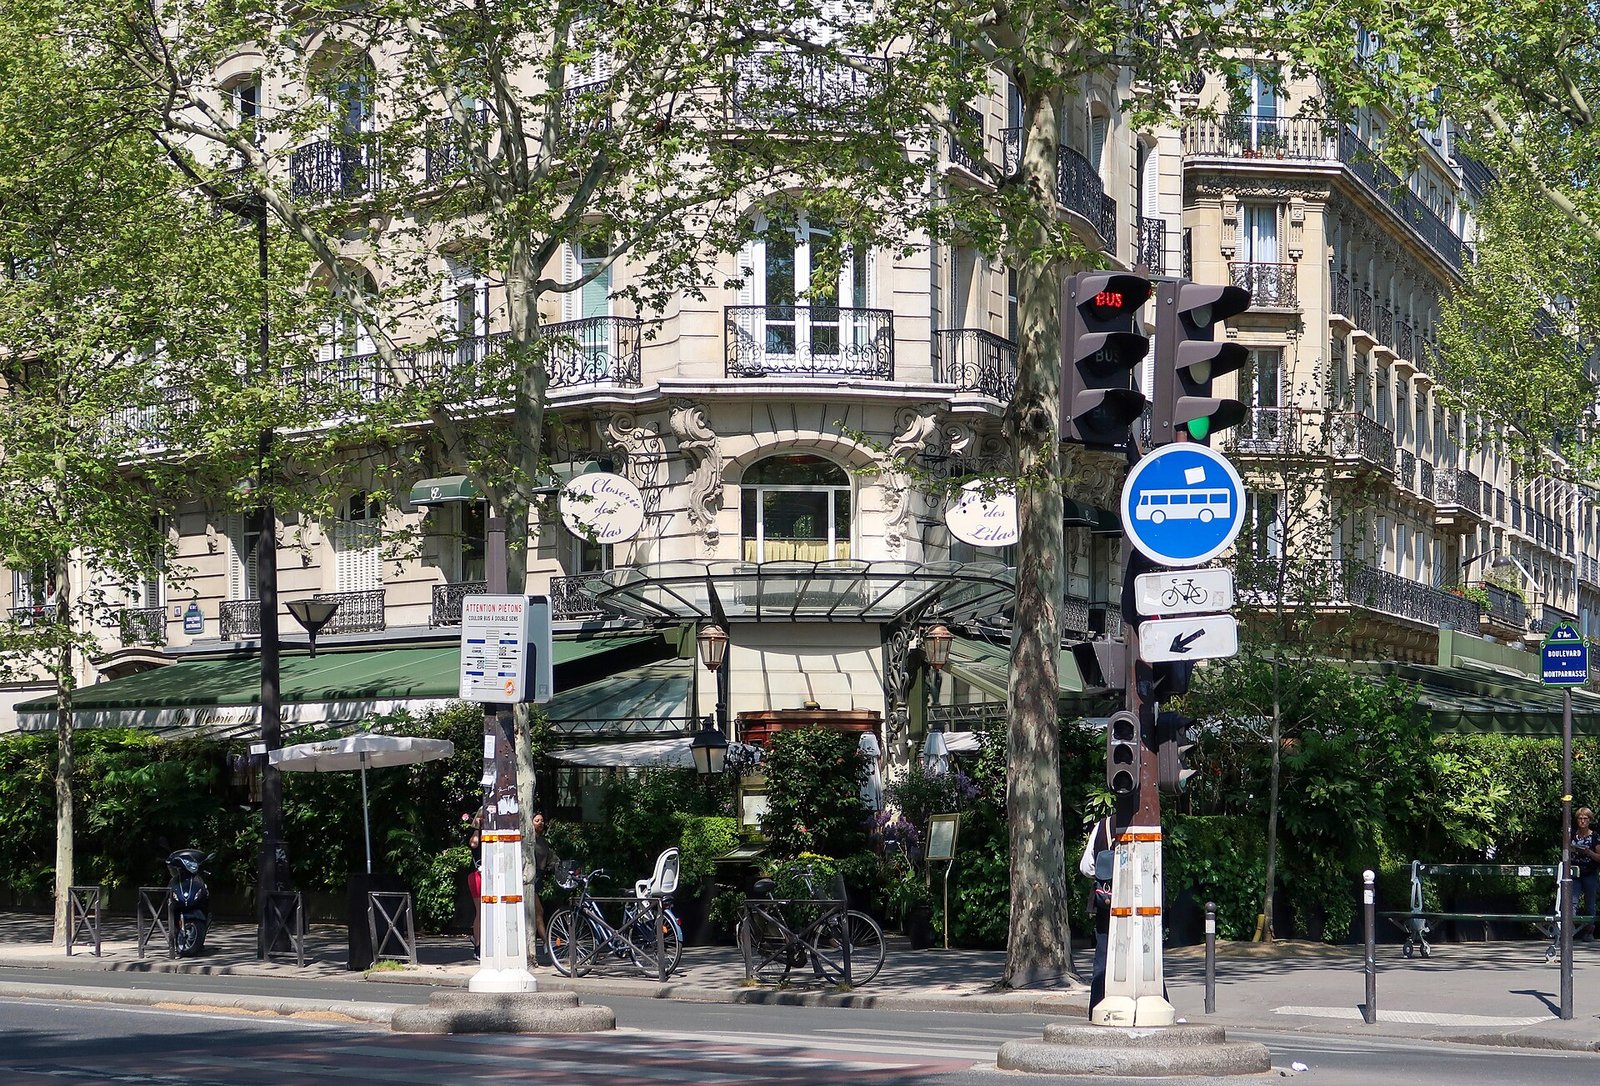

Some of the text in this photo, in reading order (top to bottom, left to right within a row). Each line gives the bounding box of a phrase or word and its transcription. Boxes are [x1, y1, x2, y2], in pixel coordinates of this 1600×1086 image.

[1095, 291, 1122, 307] BUS
[591, 477, 641, 509] Closerie
[983, 504, 1006, 518] des
[966, 523, 1016, 541] Lilas
[465, 603, 522, 613] ATTENTION PIÉTONS
[1547, 650, 1582, 658] BOULEVARD
[1543, 669, 1586, 678] MONTPARNASSE
[194, 707, 235, 724] Closerie
